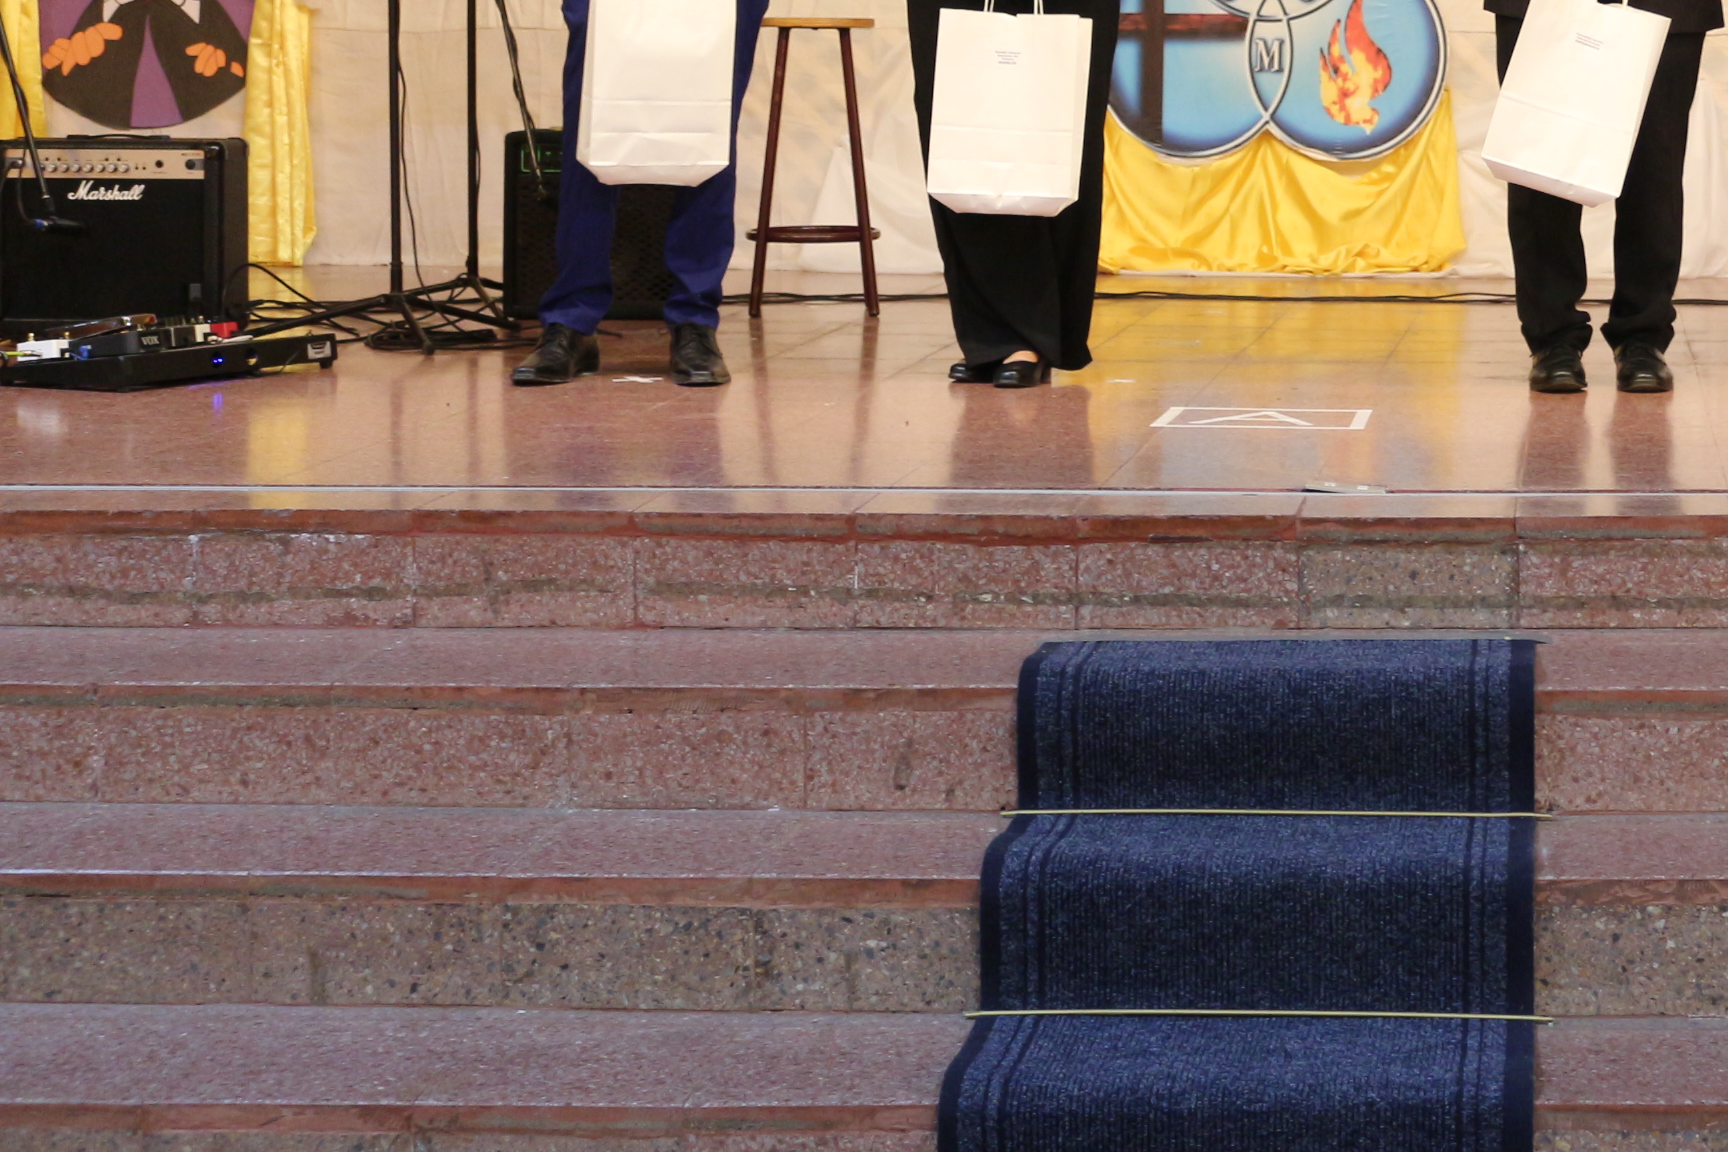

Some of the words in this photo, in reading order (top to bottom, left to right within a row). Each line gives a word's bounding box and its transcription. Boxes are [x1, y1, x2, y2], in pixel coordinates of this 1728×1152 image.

[1254, 38, 1285, 73] M
[67, 180, 146, 201] Marshall
[1188, 410, 1314, 426] A
